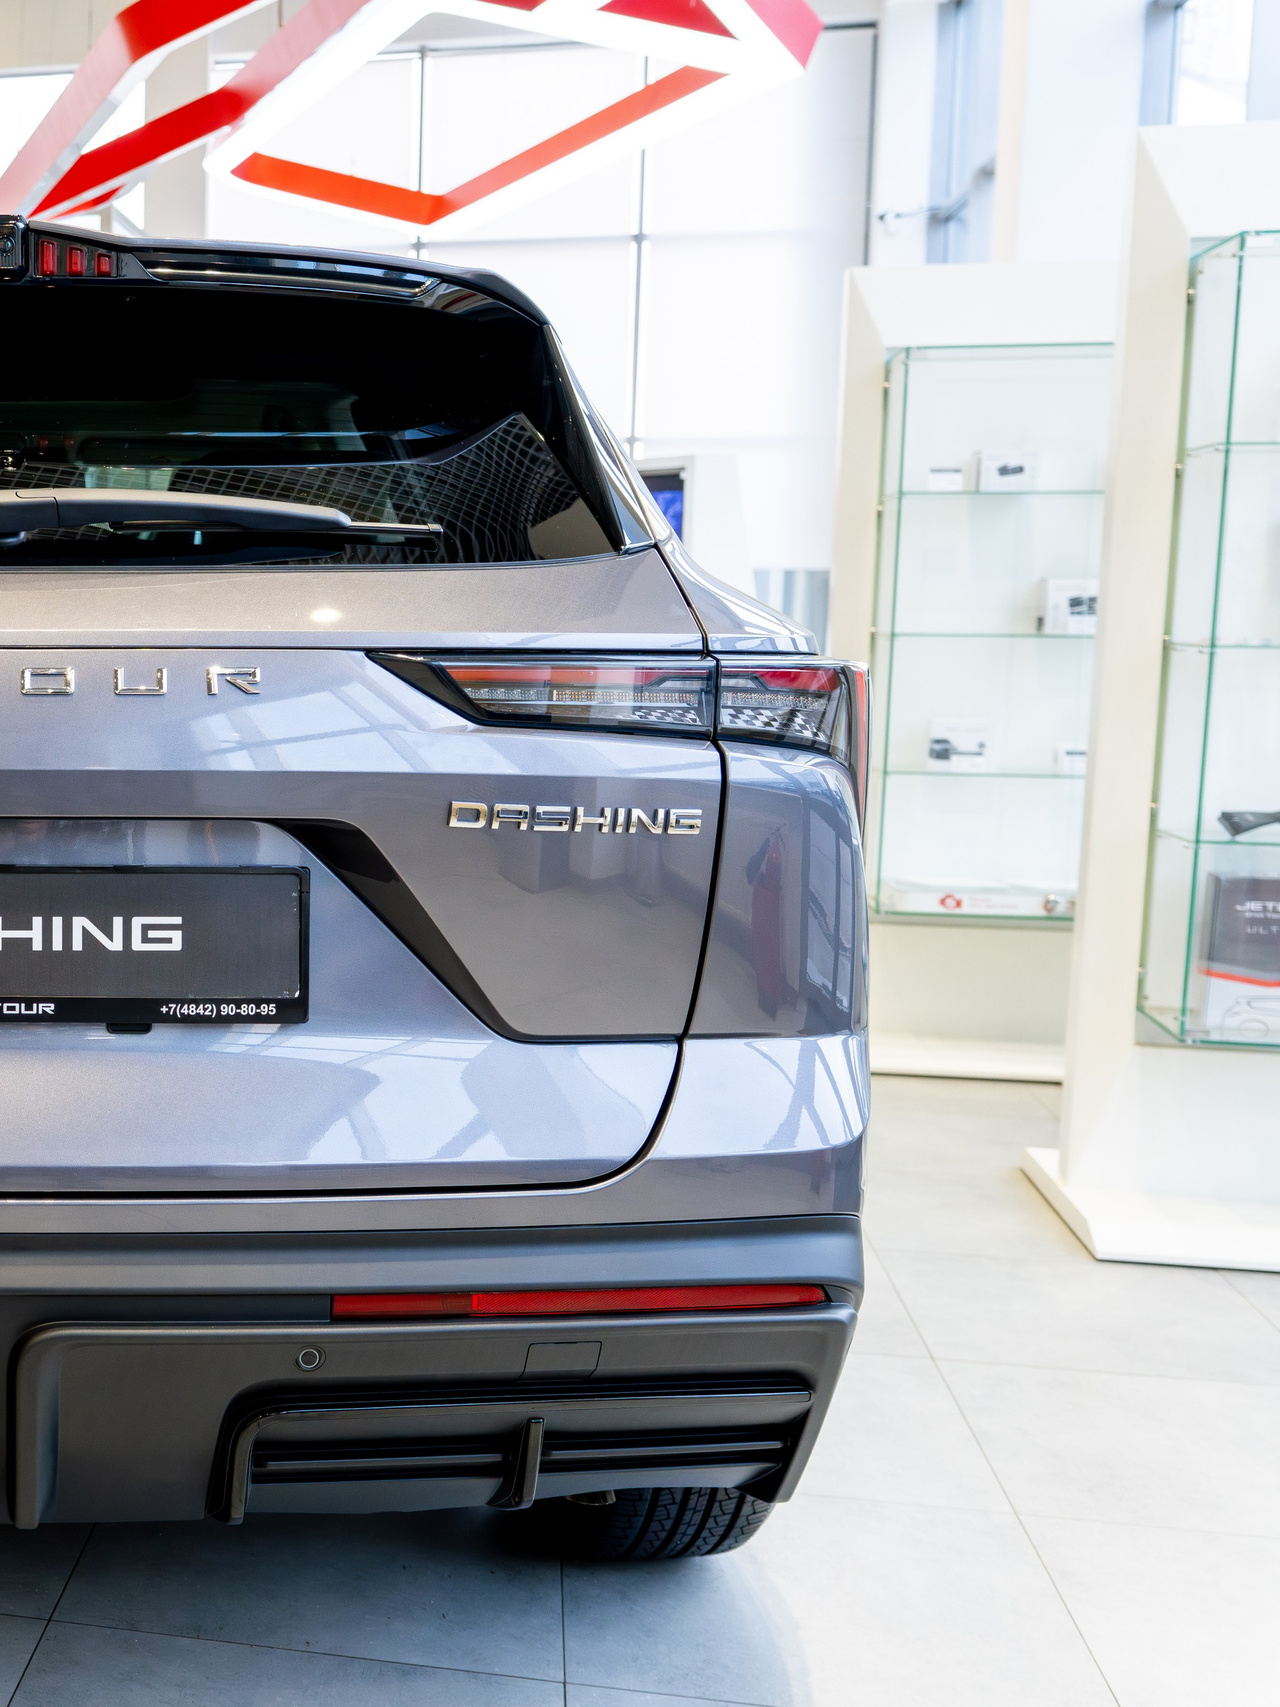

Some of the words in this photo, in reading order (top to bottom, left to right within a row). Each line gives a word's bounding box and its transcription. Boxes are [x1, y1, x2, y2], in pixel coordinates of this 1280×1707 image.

[448, 800, 703, 835] DASHING
[1234, 900, 1280, 911] JET
[160, 1003, 217, 1018] +7(4842)
[220, 1004, 277, 1016] 90-80-95
